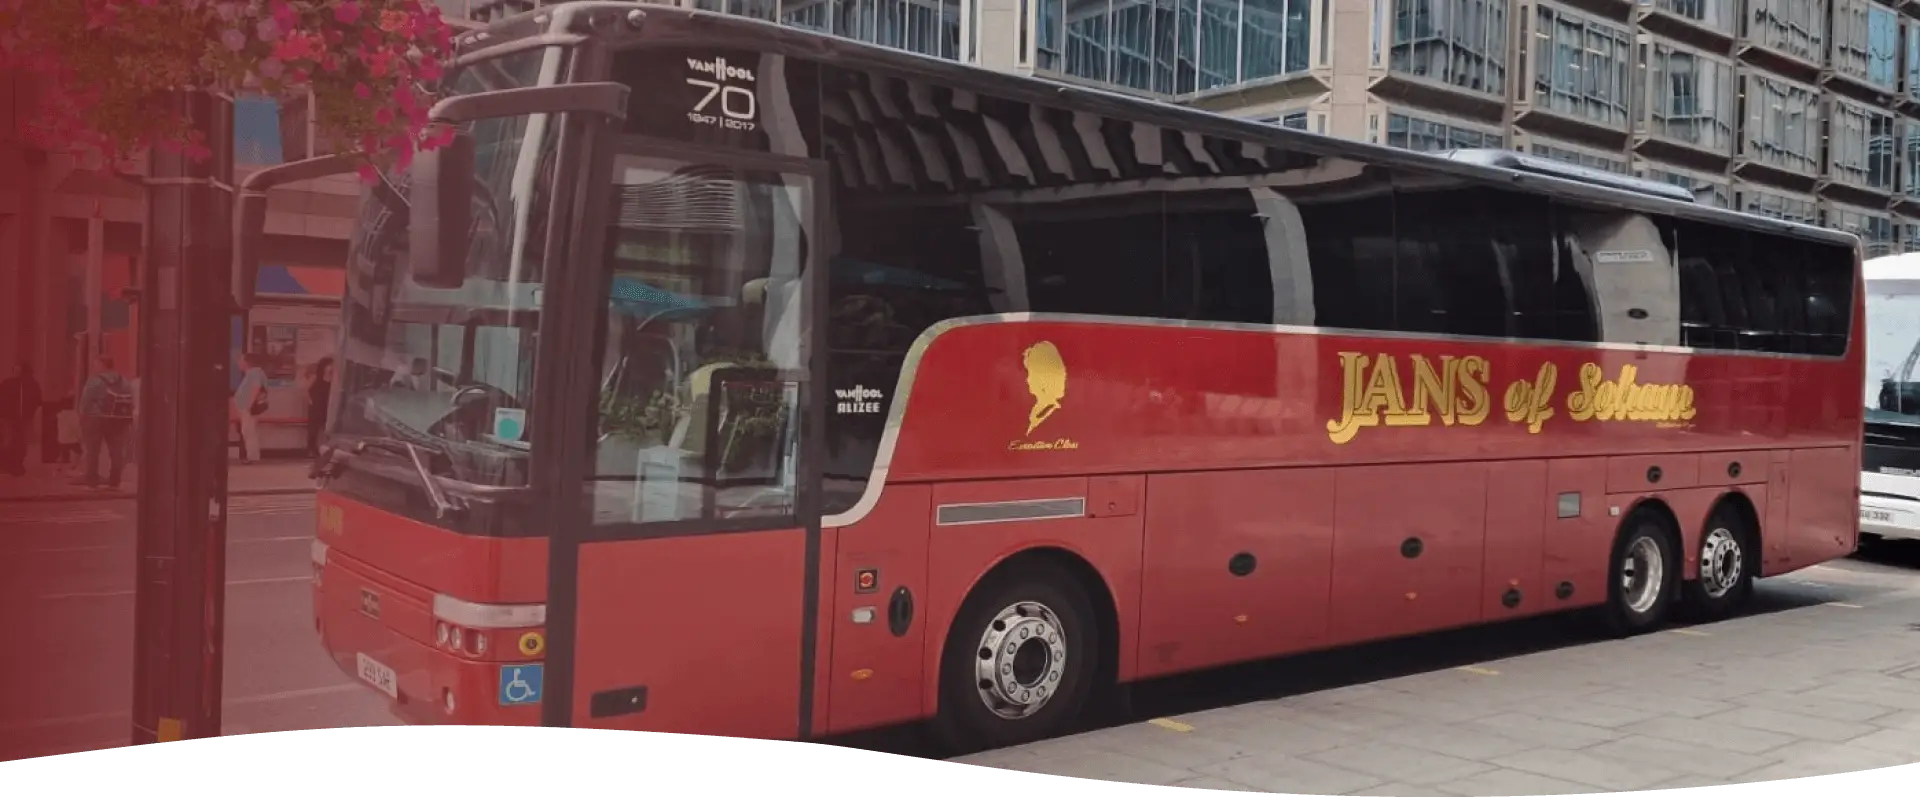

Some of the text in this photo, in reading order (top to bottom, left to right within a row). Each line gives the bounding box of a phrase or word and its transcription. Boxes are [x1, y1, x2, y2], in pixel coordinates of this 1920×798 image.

[686, 78, 755, 119] 70
[725, 118, 755, 131] 2017
[837, 402, 880, 413] ALIZEE
[1326, 351, 1490, 444] JANS
[1504, 361, 1557, 434] of
